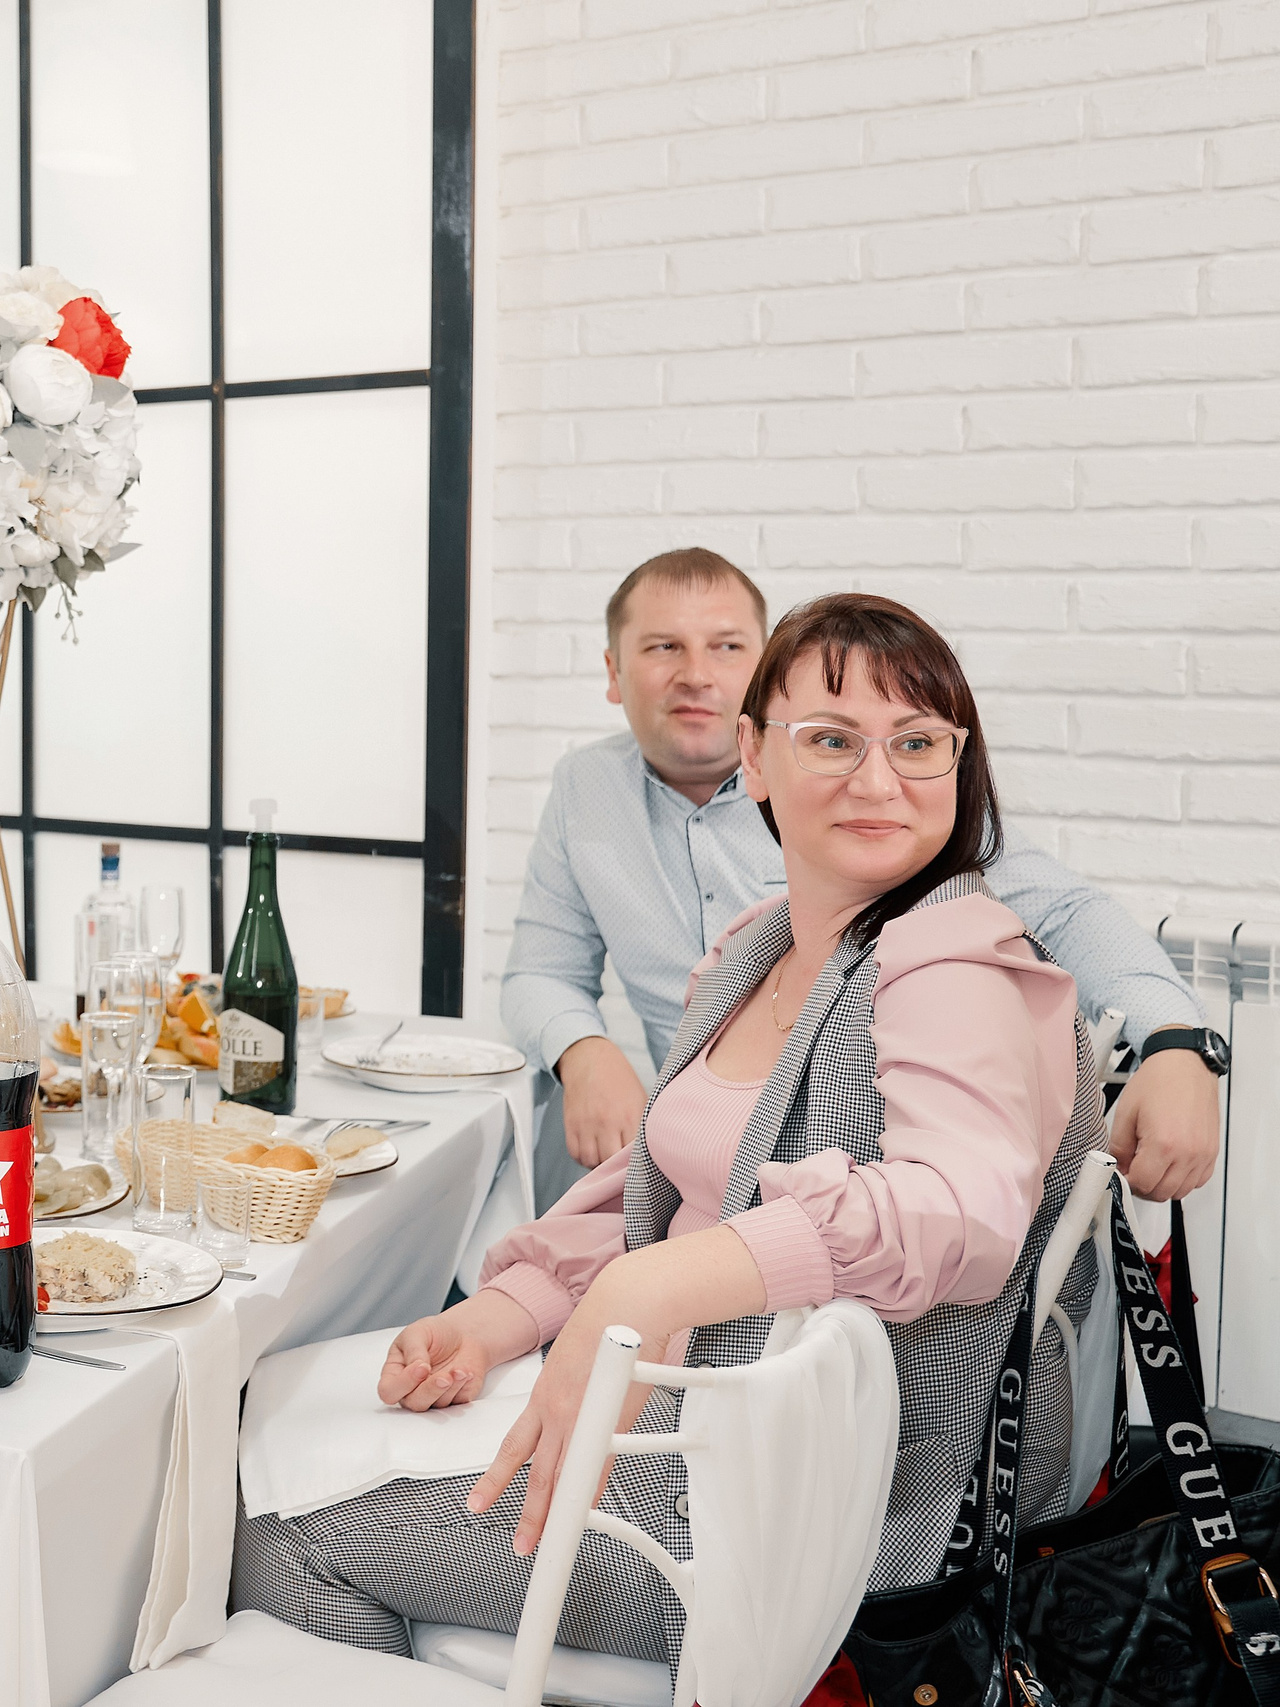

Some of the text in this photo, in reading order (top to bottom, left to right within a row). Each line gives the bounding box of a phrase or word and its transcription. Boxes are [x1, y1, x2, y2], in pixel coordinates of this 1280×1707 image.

[220, 1036, 263, 1056] OLLE
[1115, 1218, 1183, 1368] UESS
[993, 1367, 1022, 1576] GUESS
[1165, 1421, 1238, 1548] GUE
